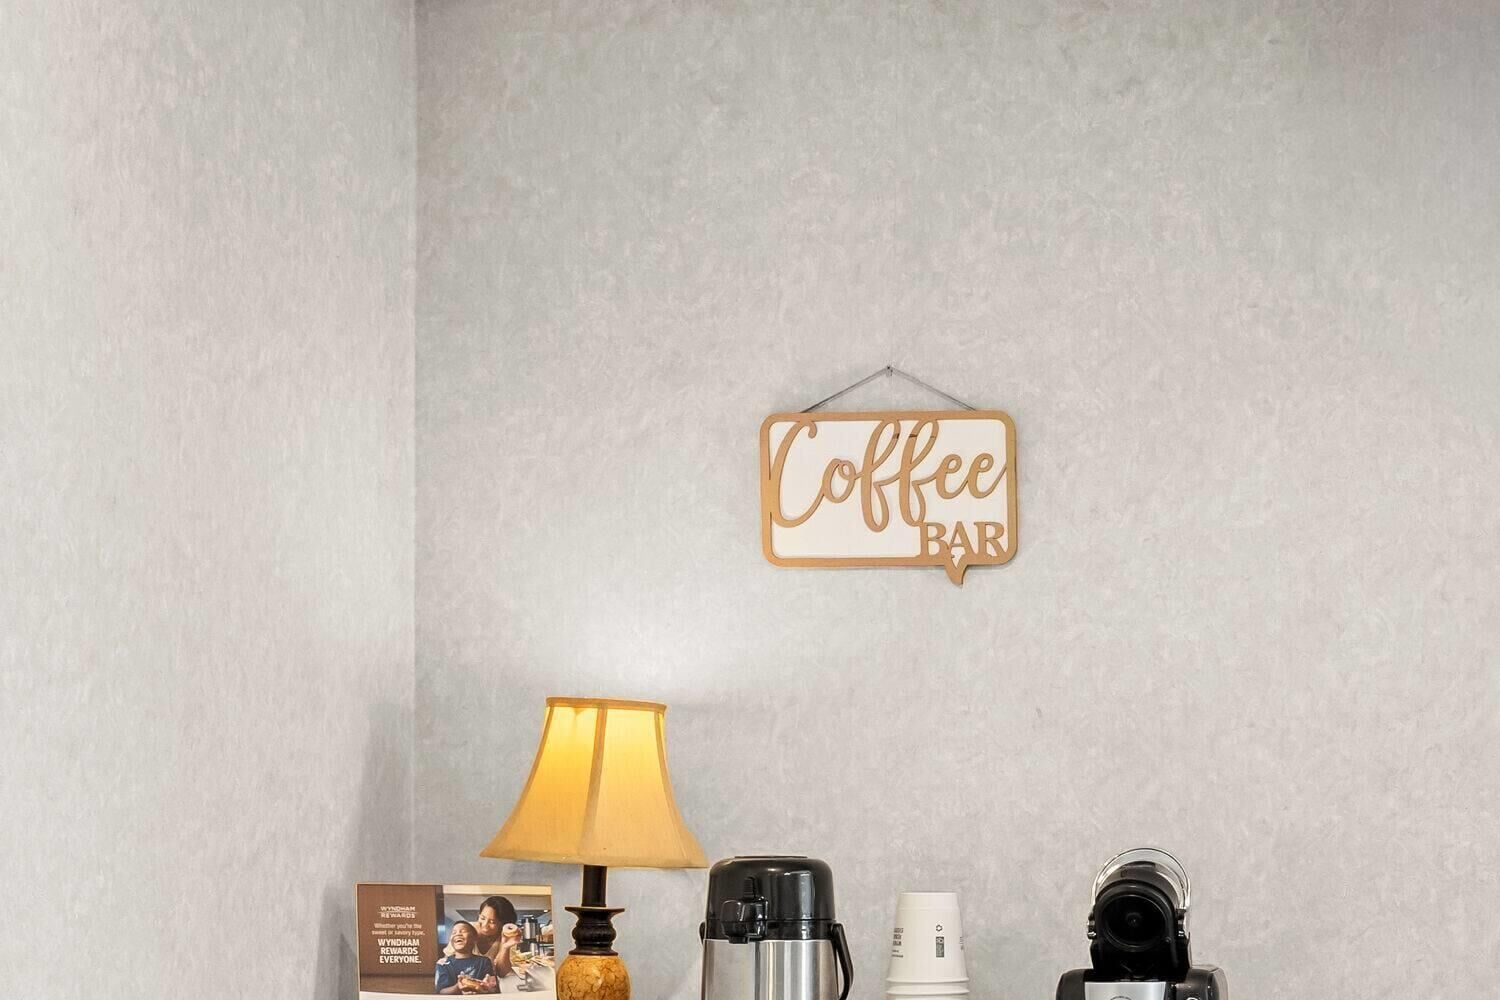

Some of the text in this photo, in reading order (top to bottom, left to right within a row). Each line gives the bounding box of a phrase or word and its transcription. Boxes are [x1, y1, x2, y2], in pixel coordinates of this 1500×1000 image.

[770, 418, 1007, 532] Coffee
[920, 521, 1007, 557] BAR
[377, 938, 420, 947] WYNDHAM
[380, 946, 419, 955] REWARDS
[379, 955, 422, 964] EVERYONE.
